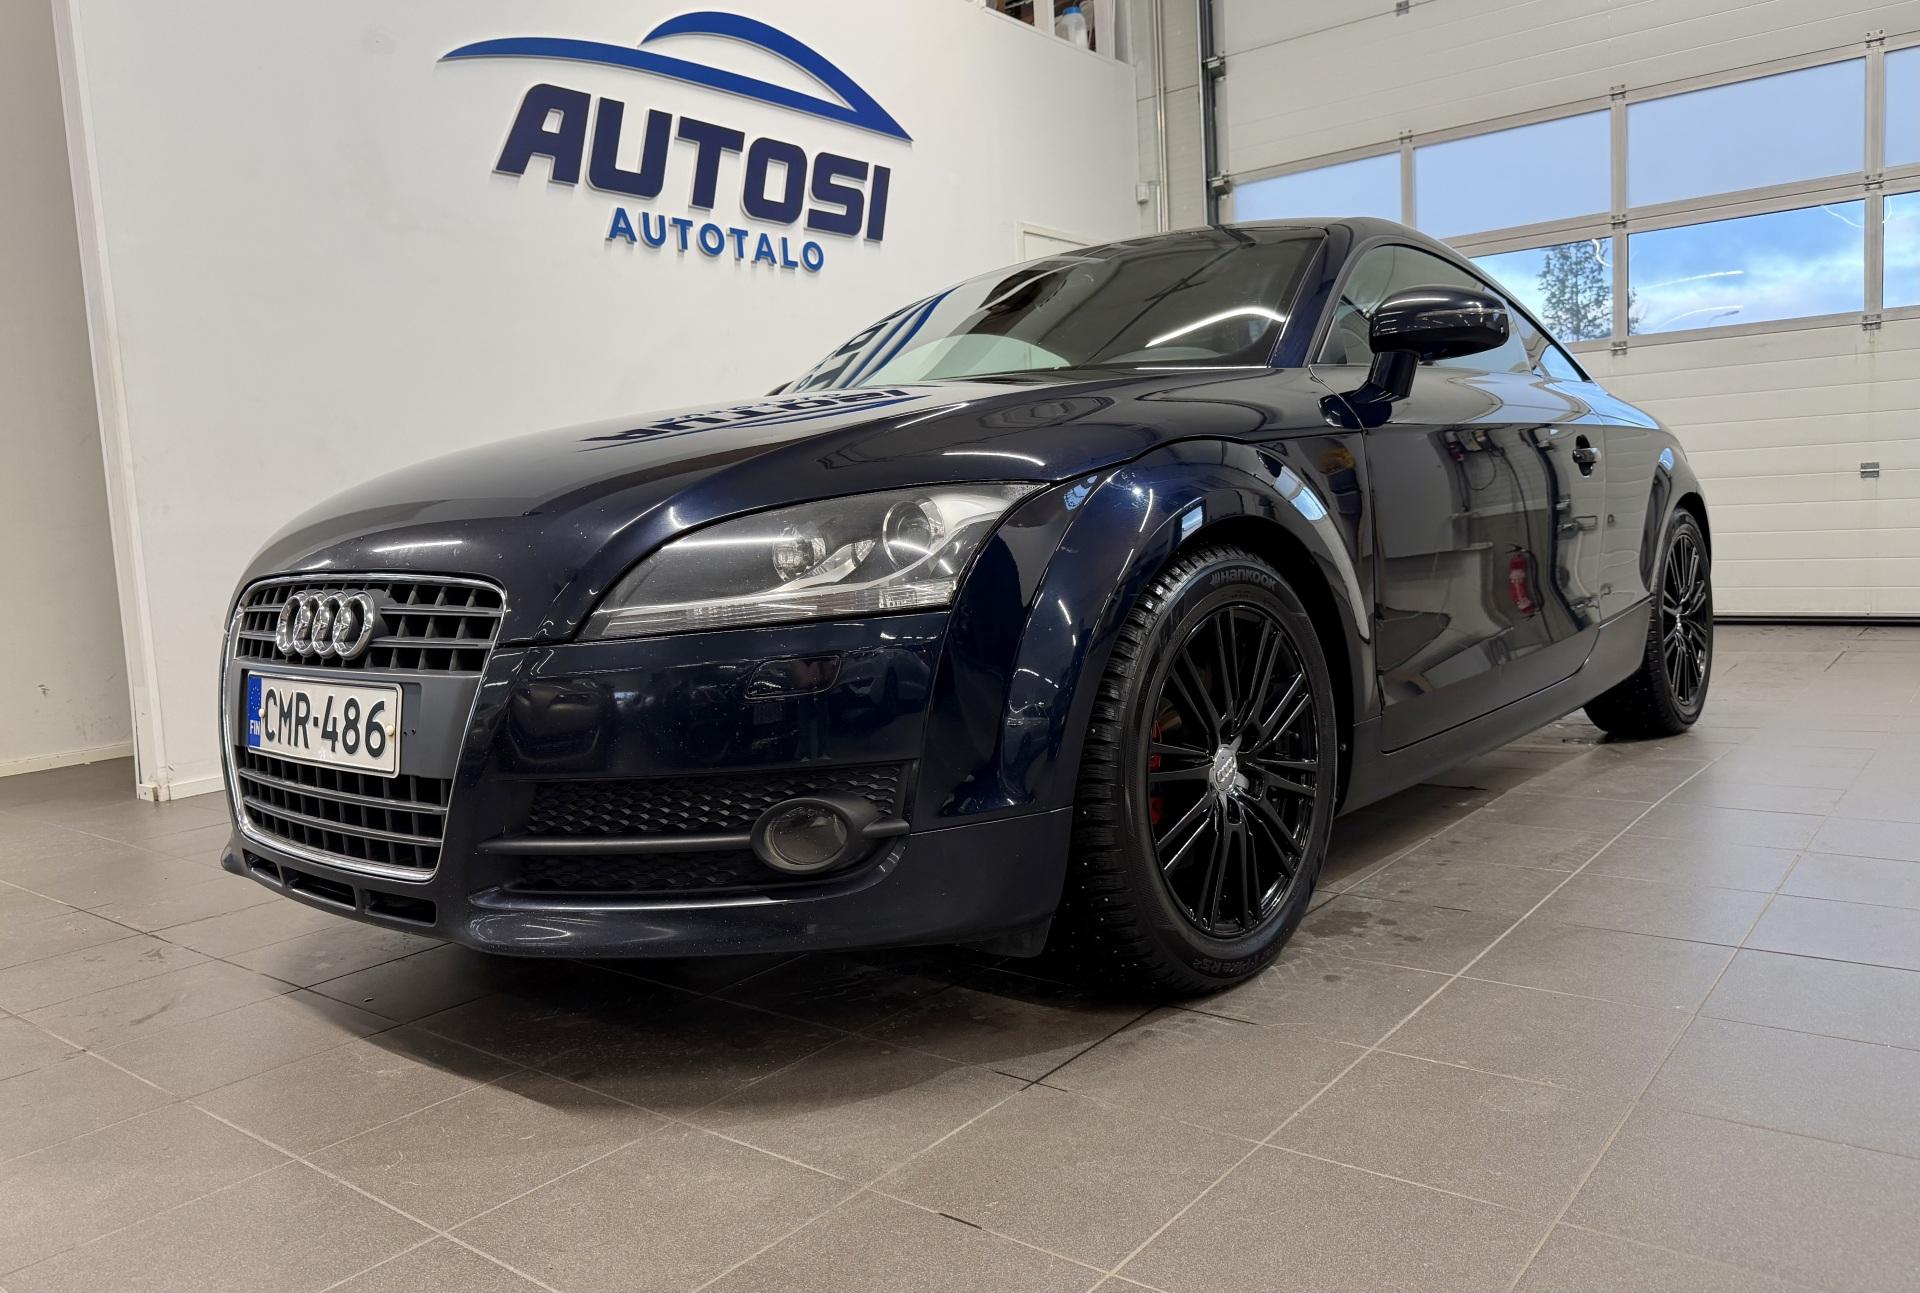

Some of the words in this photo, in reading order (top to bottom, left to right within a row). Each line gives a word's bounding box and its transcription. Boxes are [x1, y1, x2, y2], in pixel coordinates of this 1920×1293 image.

[494, 83, 891, 242] AUTOSI
[607, 207, 825, 272] AUTOTALO
[250, 719, 261, 734] FIN
[264, 688, 386, 758] CMR-486
